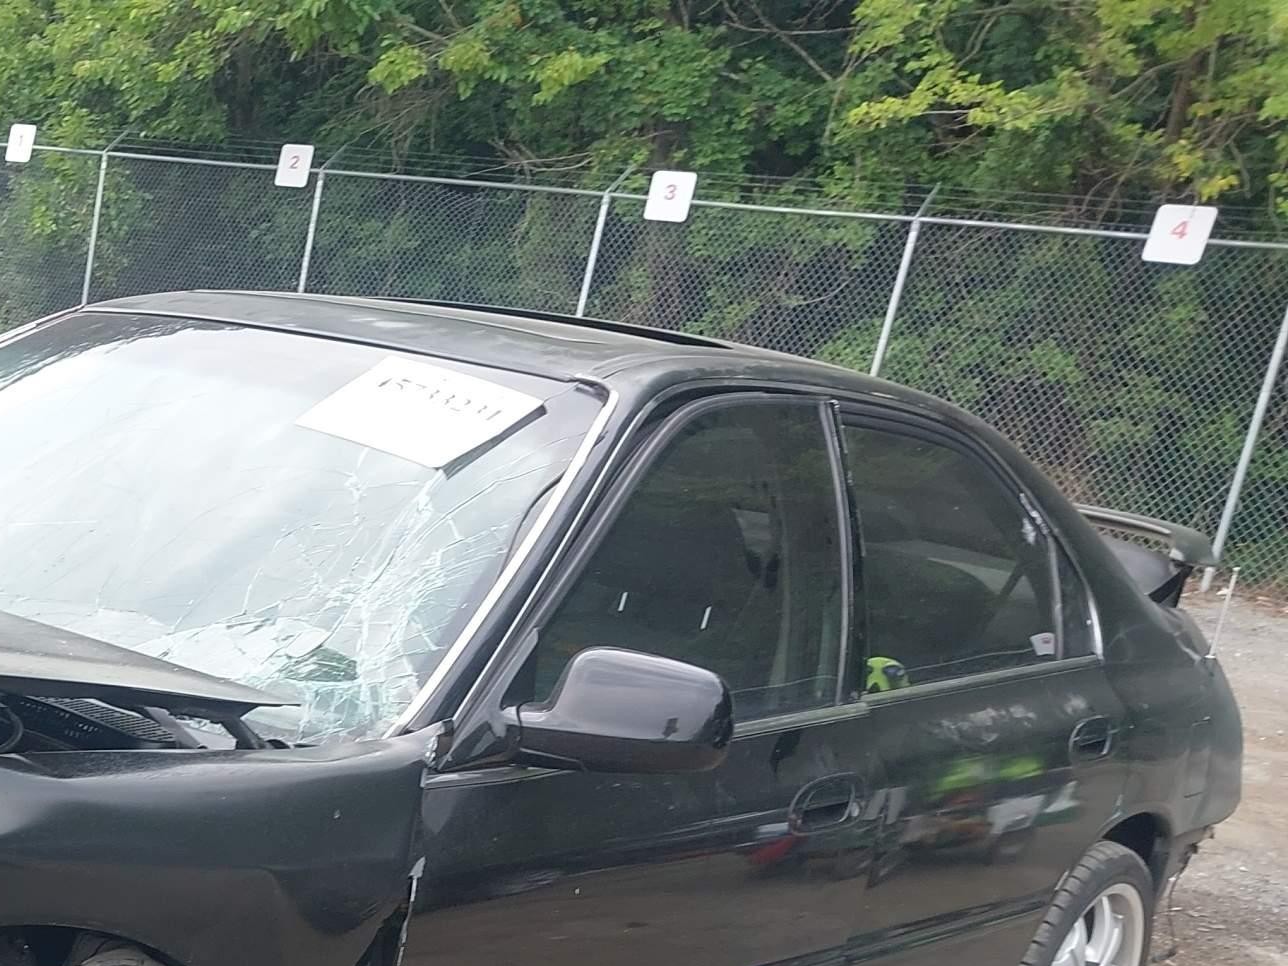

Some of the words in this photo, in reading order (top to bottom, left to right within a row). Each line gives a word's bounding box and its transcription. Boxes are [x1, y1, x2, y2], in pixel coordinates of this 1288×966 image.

[289, 155, 300, 169] 2
[664, 184, 678, 200] 3
[1170, 220, 1189, 239] 4
